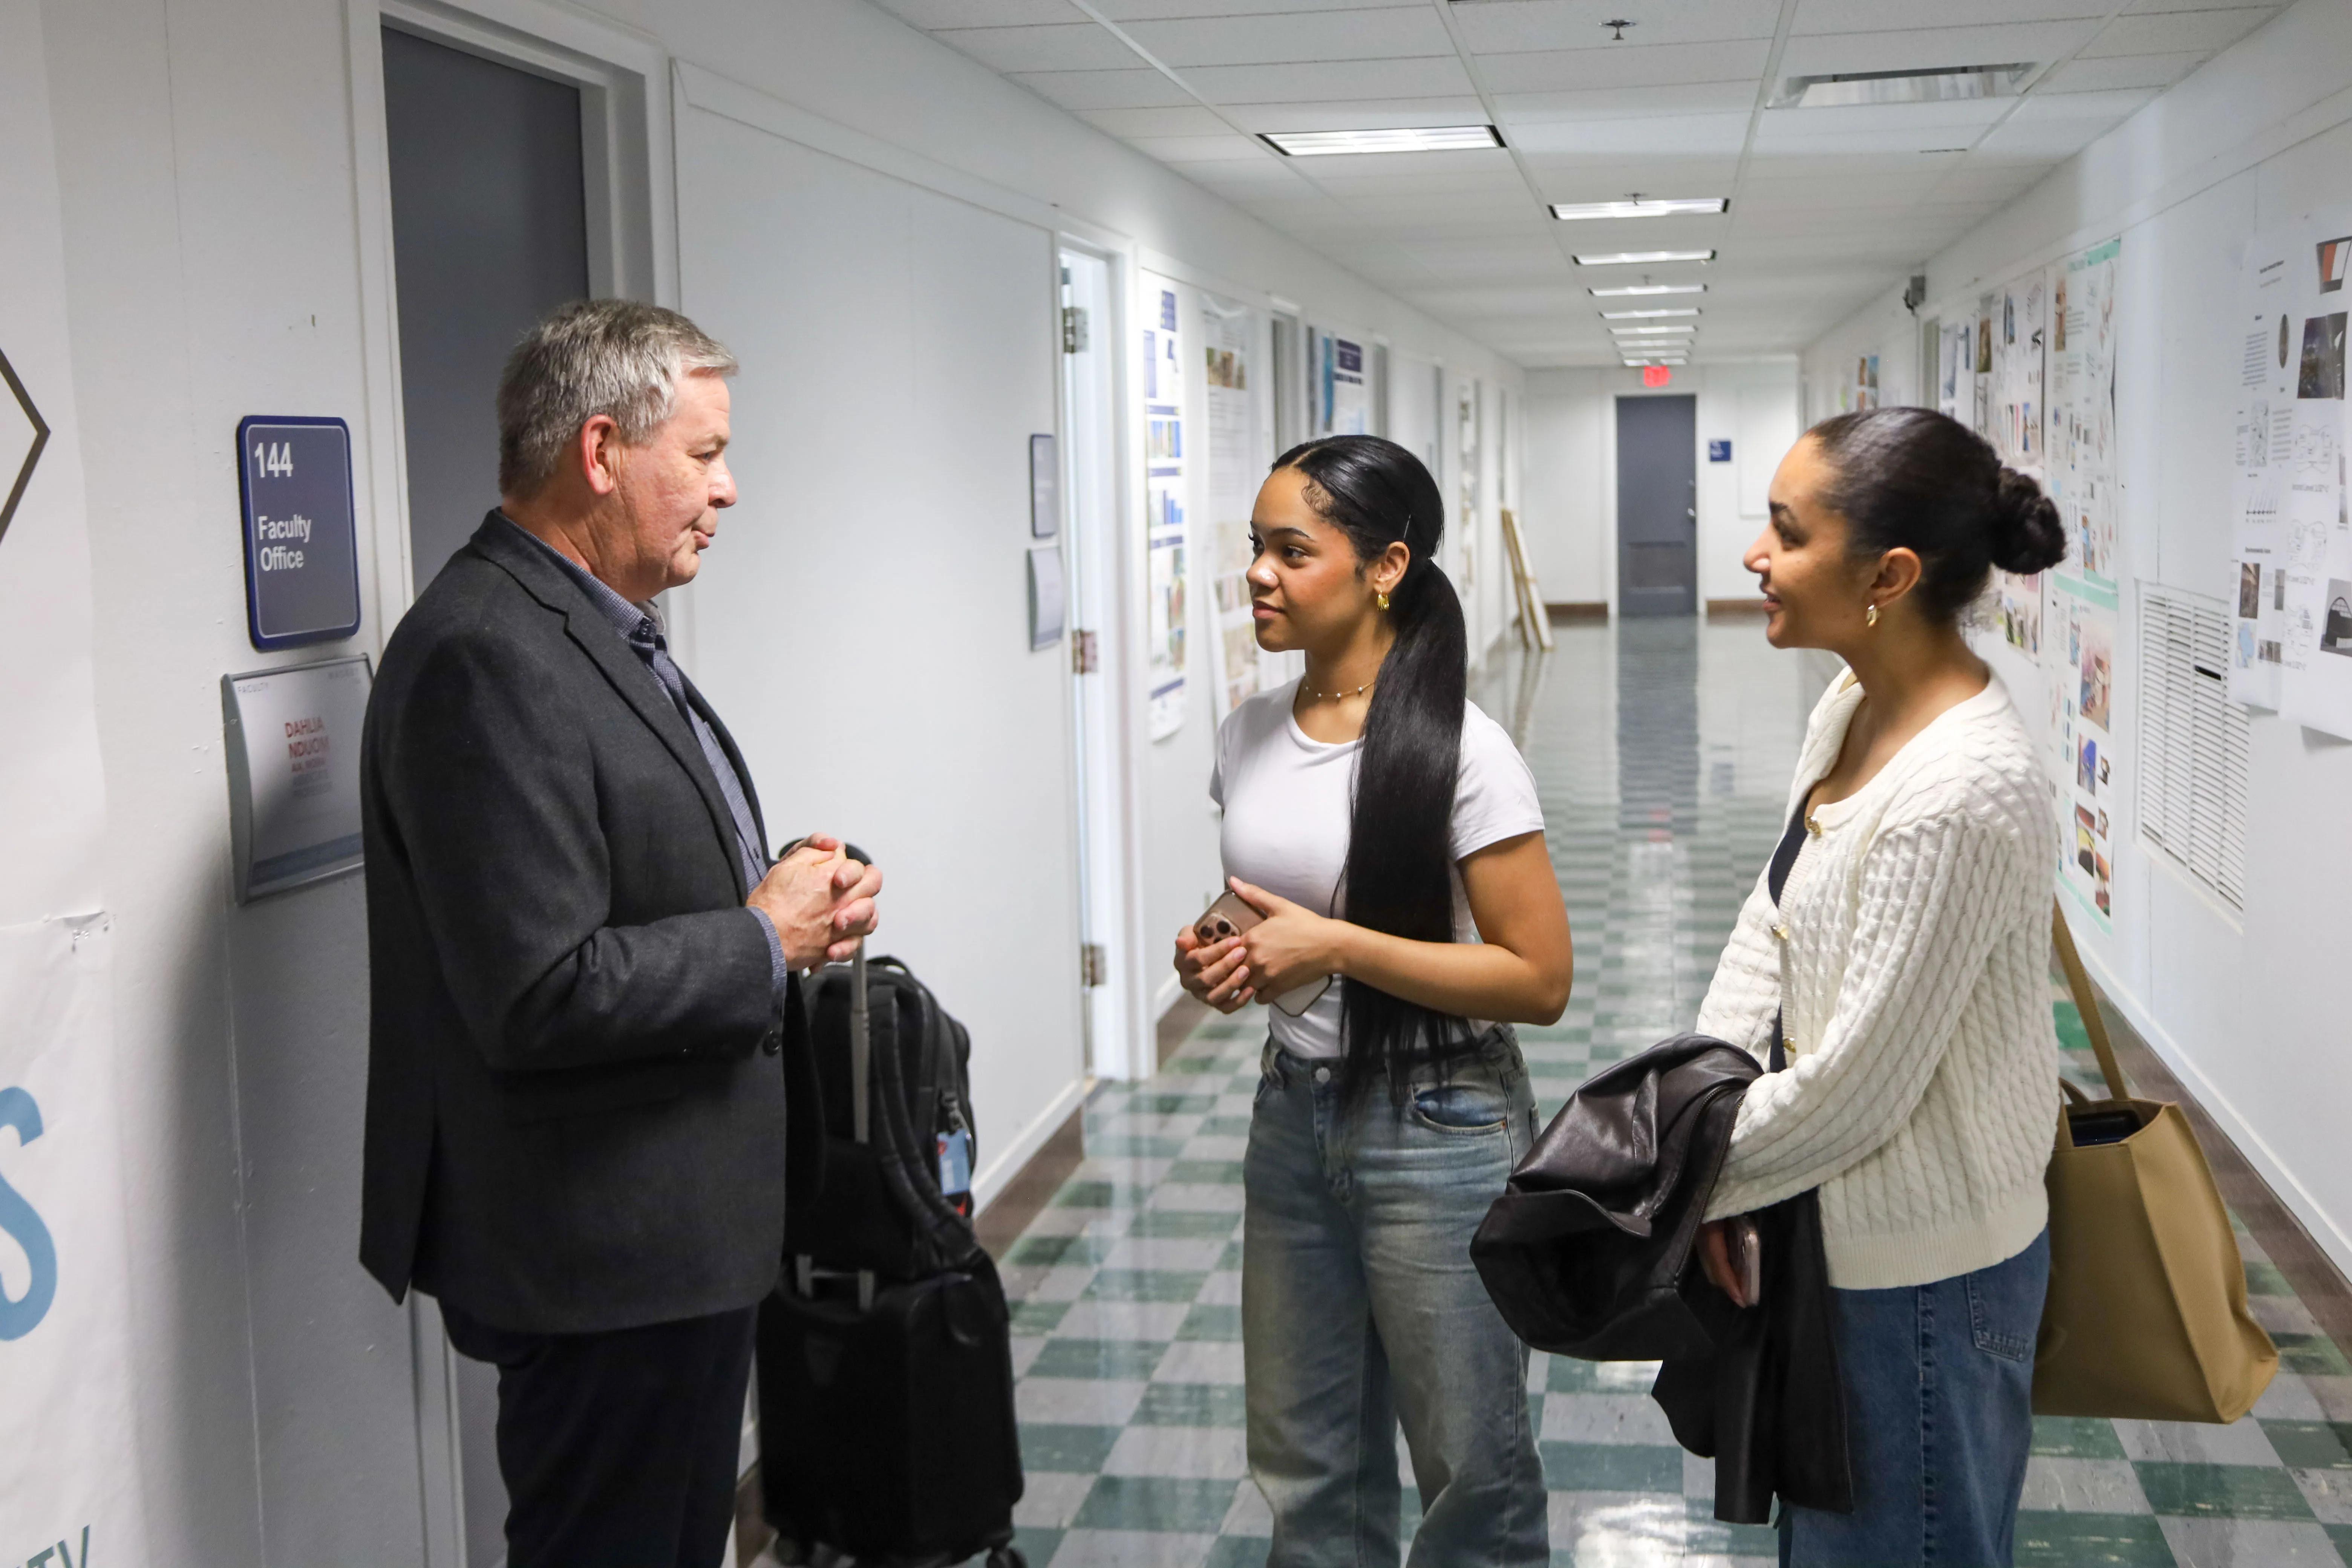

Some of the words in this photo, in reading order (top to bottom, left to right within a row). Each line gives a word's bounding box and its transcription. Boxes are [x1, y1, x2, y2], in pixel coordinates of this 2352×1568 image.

[254, 442, 294, 478] 144
[258, 514, 312, 543] Faculty
[260, 545, 305, 572] Office
[285, 717, 325, 738] DAHLIA
